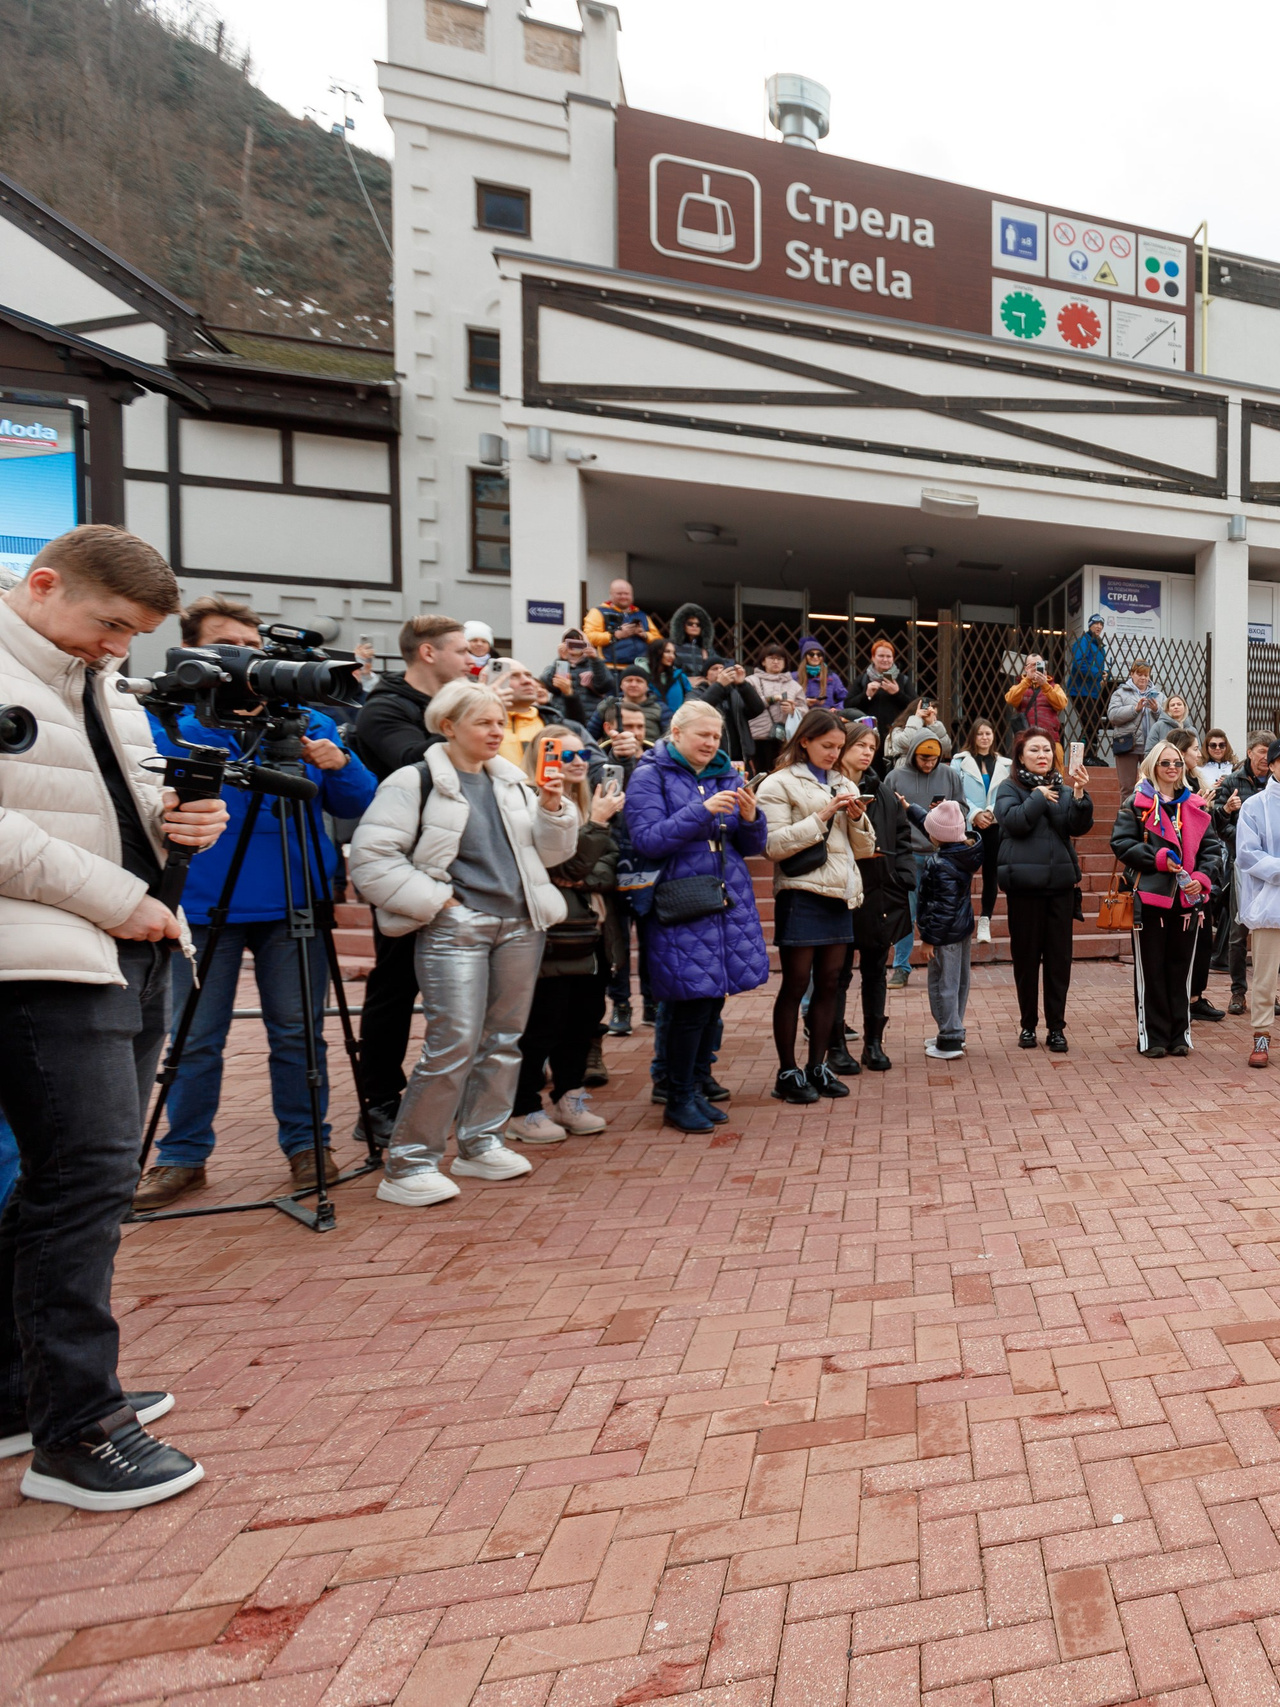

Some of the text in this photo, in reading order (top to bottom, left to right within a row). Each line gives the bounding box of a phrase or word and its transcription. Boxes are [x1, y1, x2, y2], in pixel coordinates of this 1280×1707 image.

[785, 181, 935, 248] Стрела
[785, 239, 913, 300] Strela
[1107, 592, 1139, 602] СТРЕЛА
[1248, 628, 1266, 636] ВХОД
